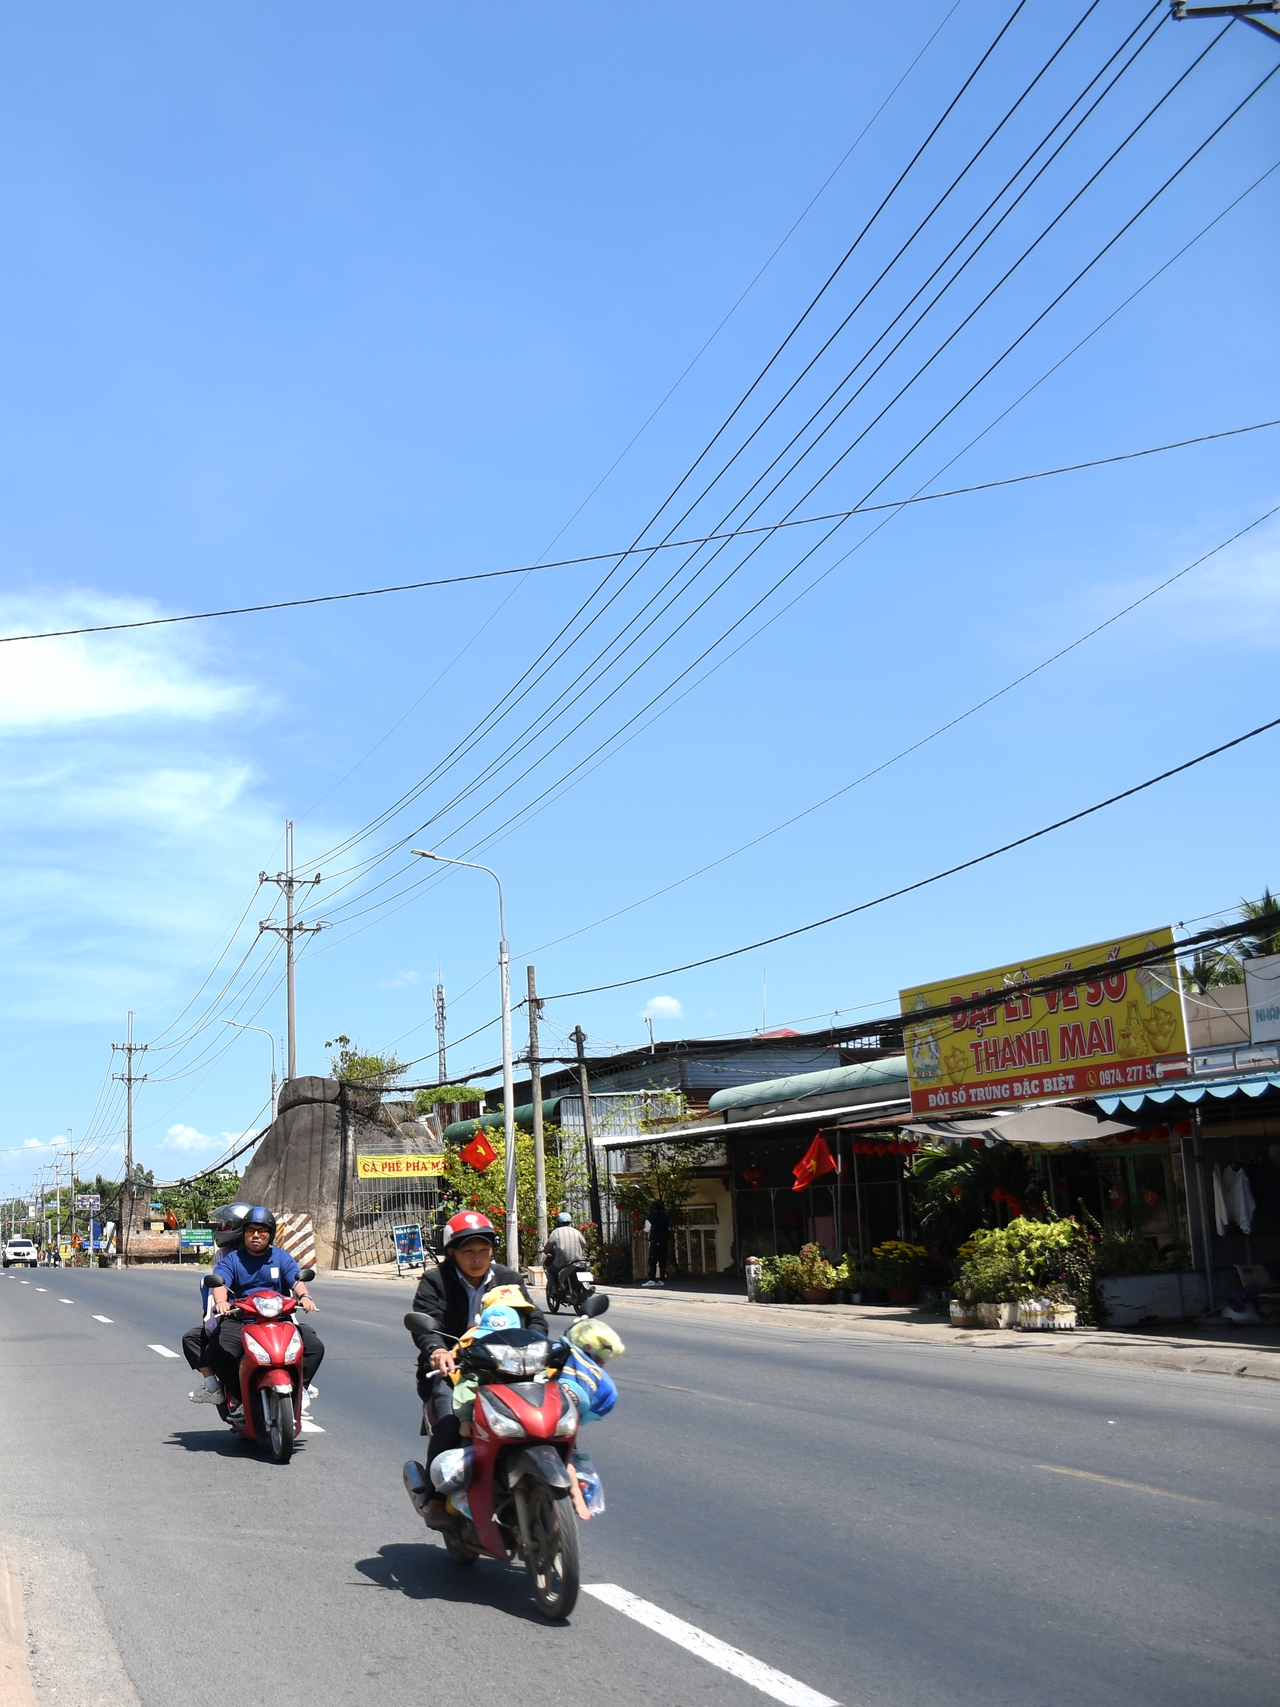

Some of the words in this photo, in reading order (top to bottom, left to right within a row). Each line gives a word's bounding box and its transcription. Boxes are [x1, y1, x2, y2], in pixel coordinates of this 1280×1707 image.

[969, 1028, 1051, 1074] THANH
[1059, 1016, 1115, 1061] MAI
[1099, 1068, 1124, 1086] 0974.
[1126, 1065, 1143, 1082] 277
[928, 1087, 950, 1107] ĐỔI
[952, 1085, 967, 1104] SỐ
[969, 1083, 1010, 1102] TRÚNG
[1013, 1078, 1039, 1098] ĐẶC
[1043, 1073, 1075, 1093] BIỆT
[363, 1161, 378, 1172] CÀ
[381, 1160, 402, 1172] PHÊ
[406, 1161, 428, 1172] PHA
